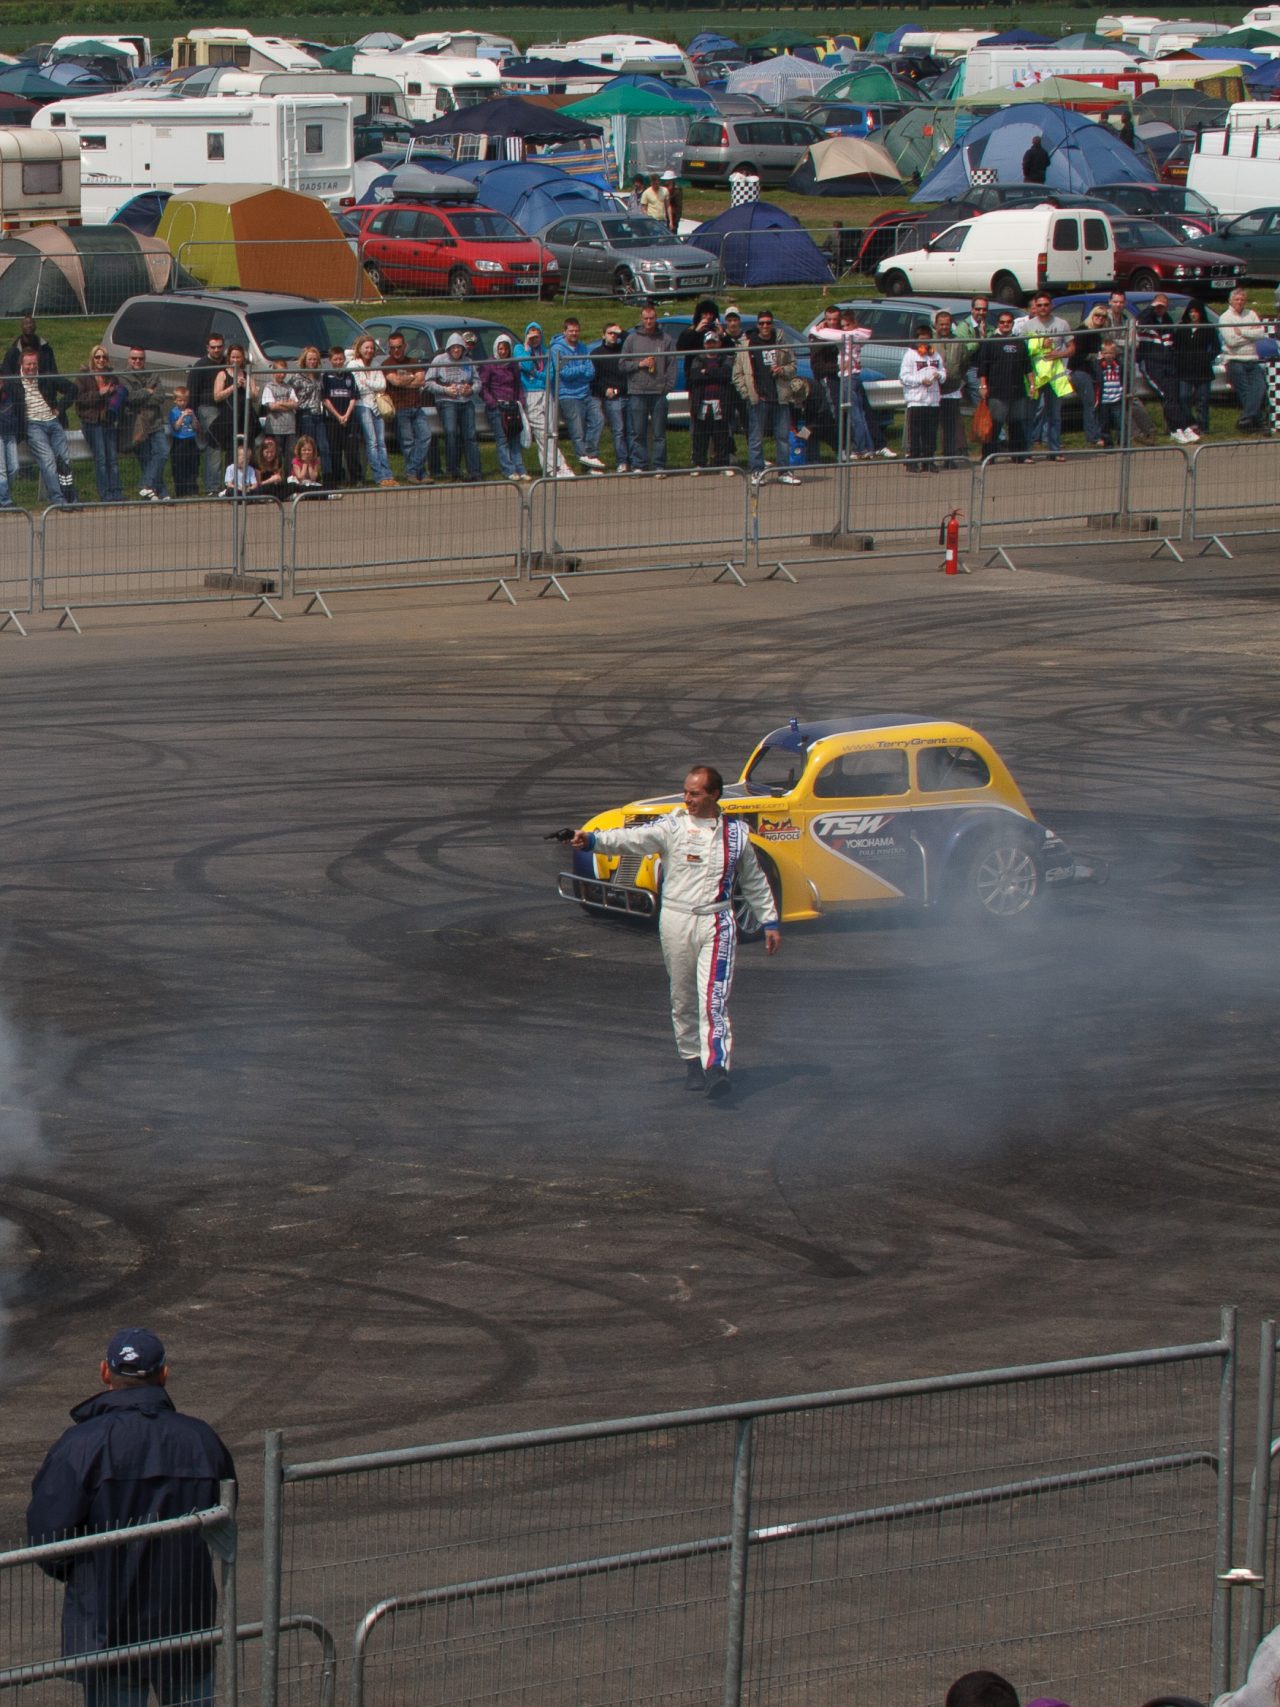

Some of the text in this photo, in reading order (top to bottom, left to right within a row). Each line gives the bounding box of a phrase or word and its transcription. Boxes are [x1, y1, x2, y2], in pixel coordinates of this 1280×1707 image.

[299, 181, 338, 191] OADSTAR
[842, 735, 973, 751] www.TerryGrant.com
[818, 814, 896, 836] TSW
[845, 836, 895, 849] YOKOHAMA
